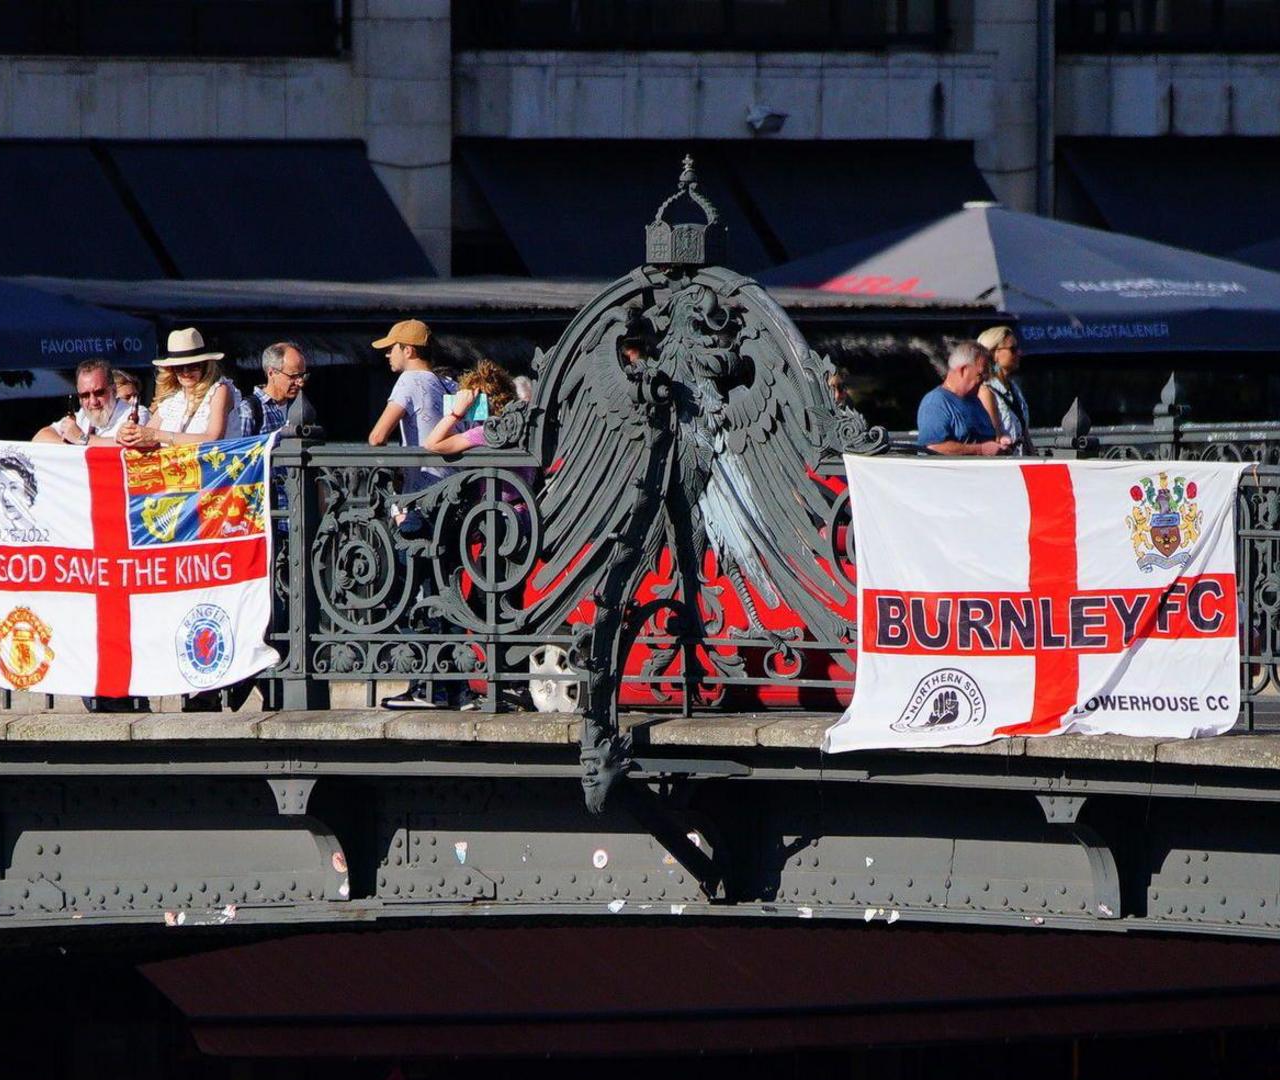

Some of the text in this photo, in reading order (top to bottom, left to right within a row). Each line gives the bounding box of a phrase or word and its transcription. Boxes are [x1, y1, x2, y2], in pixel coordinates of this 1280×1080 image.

[40, 338, 102, 353] FAVORITE
[55, 554, 110, 586] SAVE
[117, 556, 168, 586] THE
[175, 552, 233, 585] KING
[876, 579, 1226, 650] BURNLEY FC
[909, 672, 982, 714] NORTHERN SOUL
[1206, 695, 1230, 711] CC
